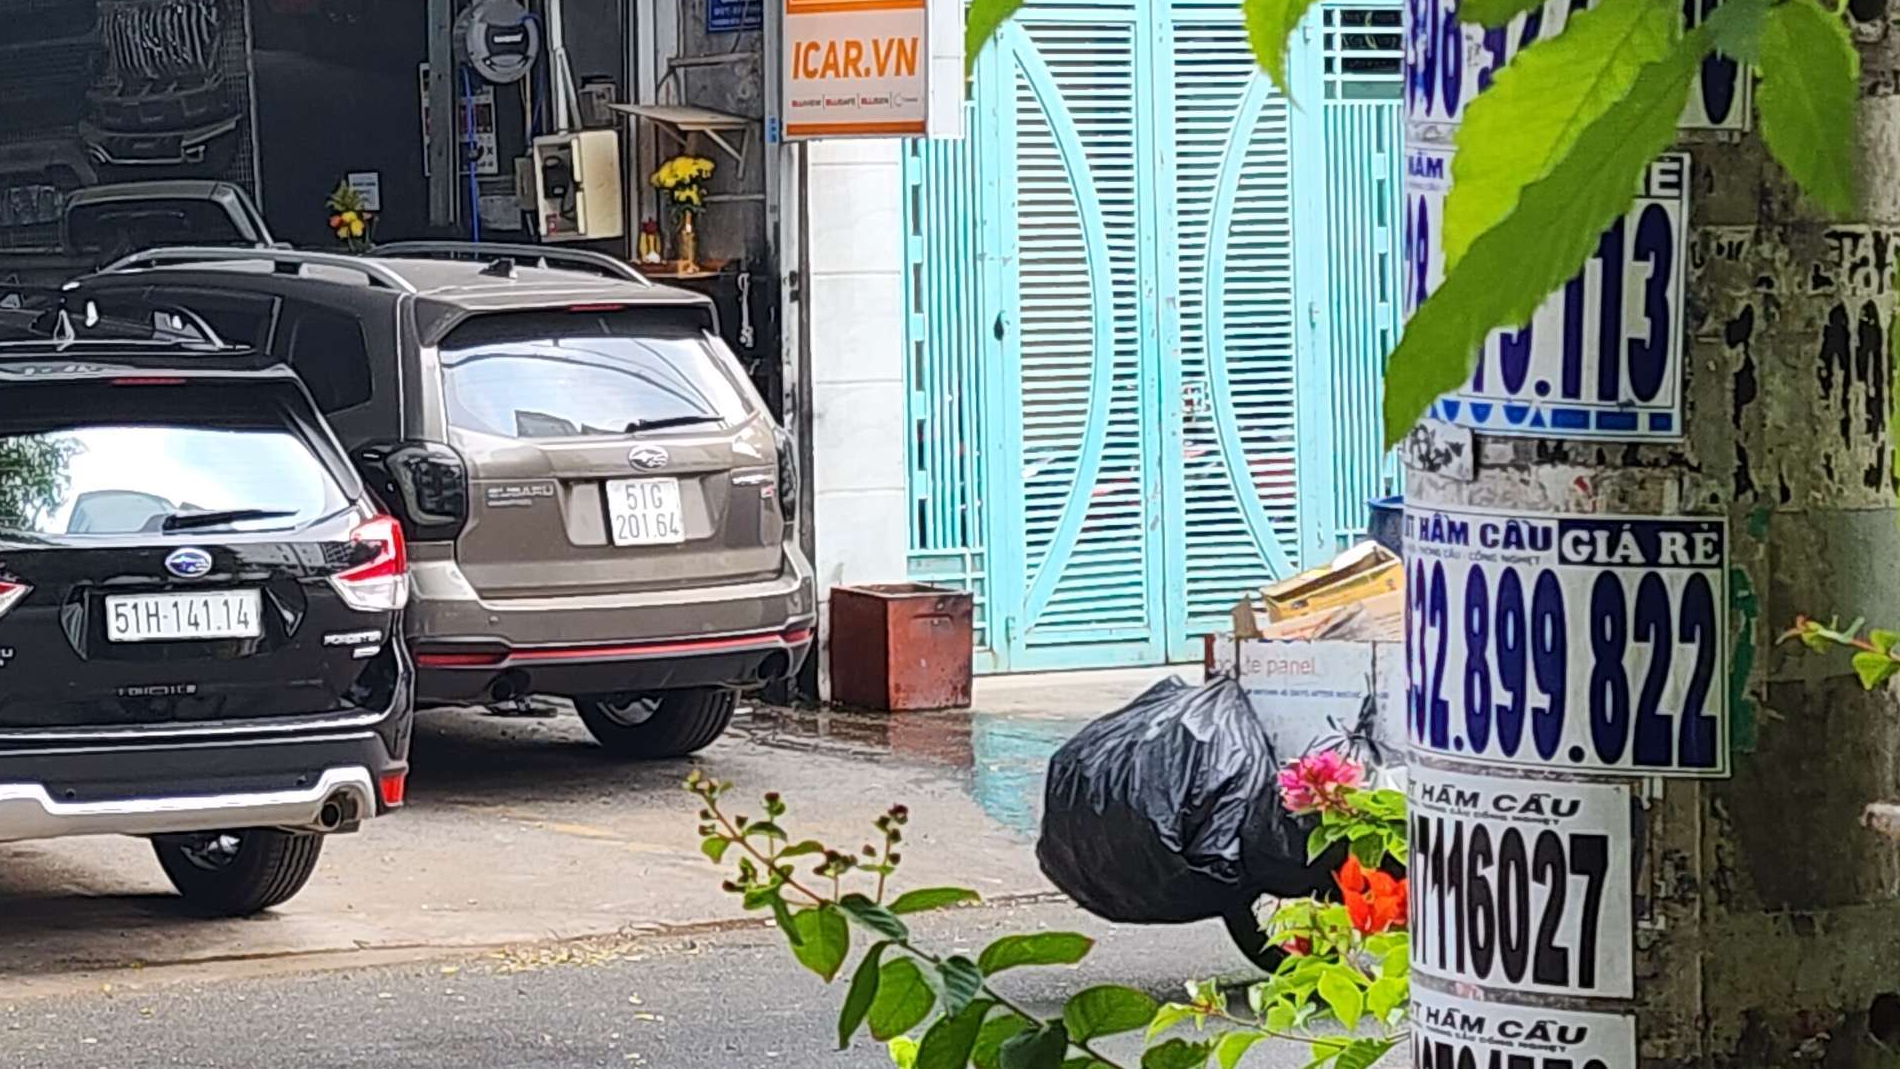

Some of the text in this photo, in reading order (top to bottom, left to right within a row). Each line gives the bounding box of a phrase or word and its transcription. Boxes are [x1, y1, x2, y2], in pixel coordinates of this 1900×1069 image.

[792, 37, 919, 80] ICAR.VN
[626, 483, 663, 511] 51G
[615, 513, 680, 541] 201.64
[1479, 519, 1553, 551] CẦU
[1561, 523, 1646, 564] GIÁ
[1658, 524, 1720, 565] RẺ
[113, 597, 251, 634] 51H-141.14
